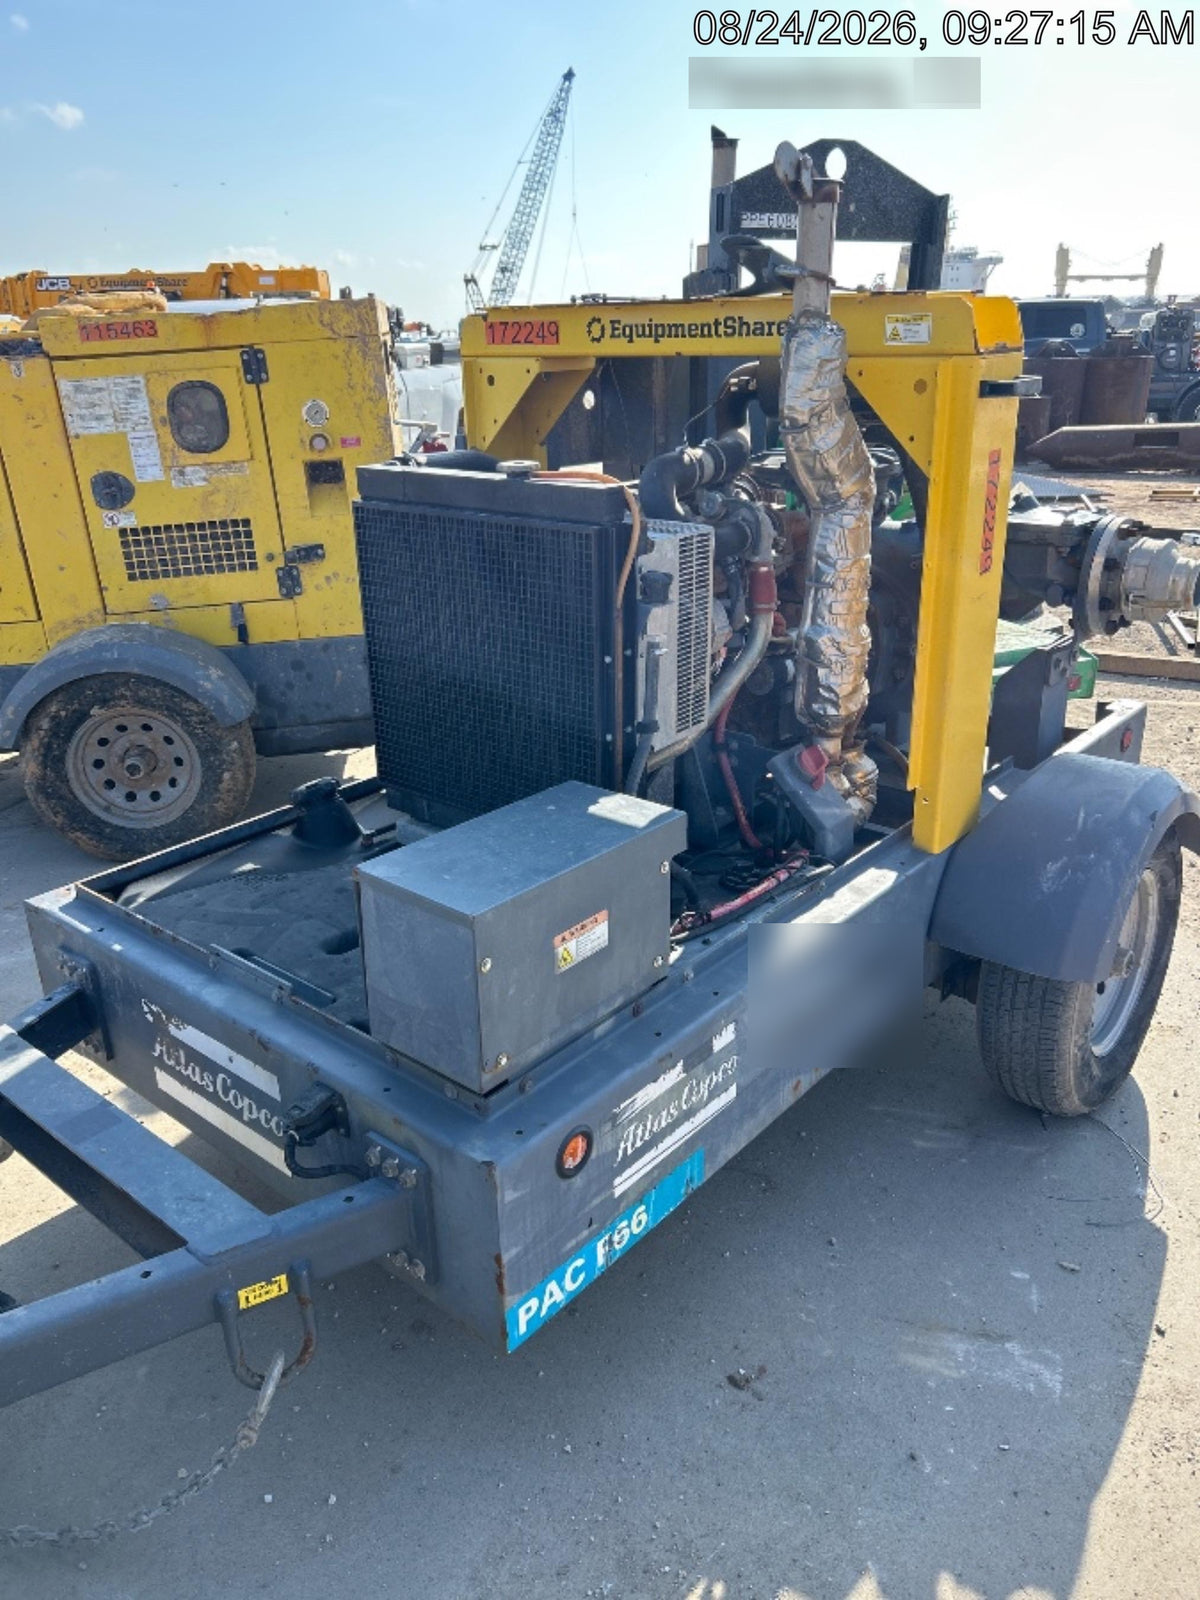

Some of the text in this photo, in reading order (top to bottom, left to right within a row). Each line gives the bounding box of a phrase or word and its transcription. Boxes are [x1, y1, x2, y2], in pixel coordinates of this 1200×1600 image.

[37, 278, 71, 291] JCB
[100, 276, 188, 288] EquipmeShare
[81, 319, 158, 341] 115463
[486, 320, 559, 344] 172249
[609, 315, 789, 343] EquipmentShare
[978, 447, 1001, 577] 172249
[216, 1072, 285, 1138] Copco
[613, 1099, 679, 1168] Atlas
[517, 1257, 586, 1337] PAC
